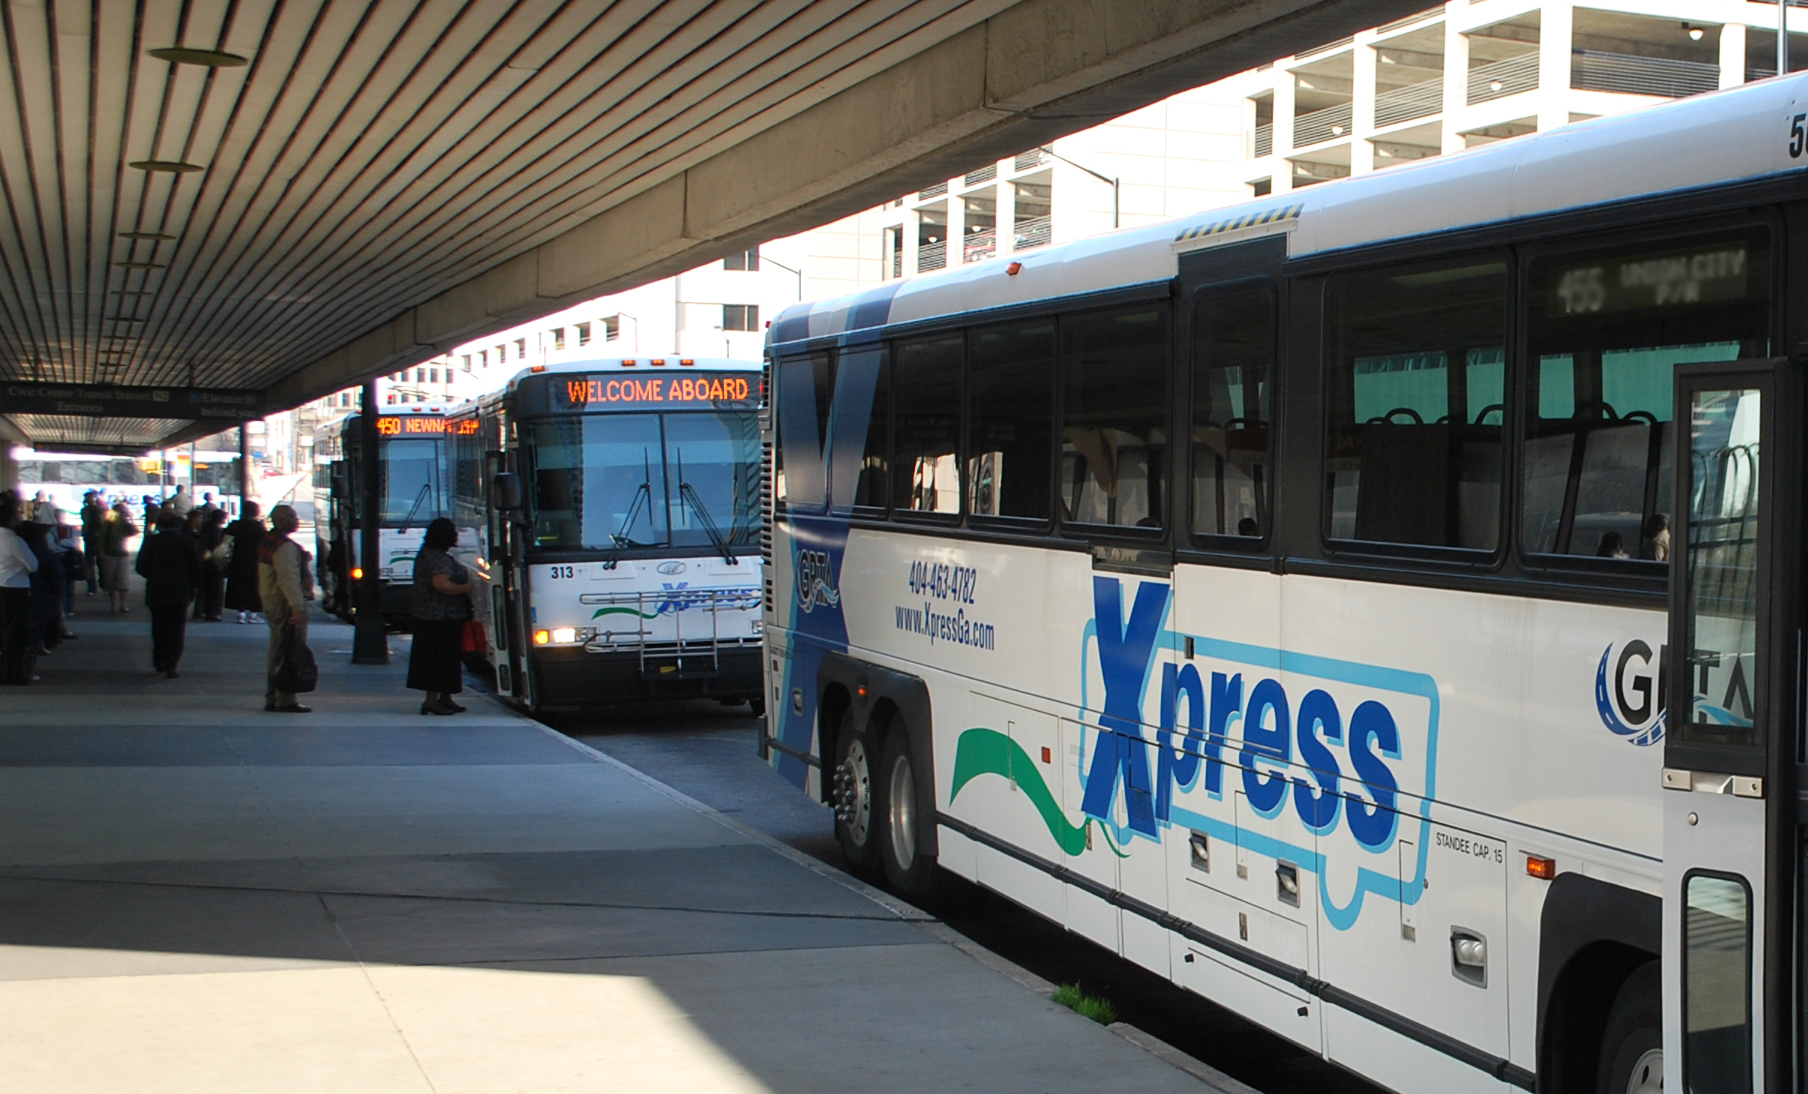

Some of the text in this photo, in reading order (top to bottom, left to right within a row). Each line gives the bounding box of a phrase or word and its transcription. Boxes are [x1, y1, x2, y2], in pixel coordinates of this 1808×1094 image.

[1789, 112, 1808, 158] 5
[1620, 249, 1746, 287] UNION CITY
[1558, 267, 1605, 313] 455
[8, 386, 36, 398] Civic
[38, 387, 75, 399] Center
[76, 388, 113, 400] Transit
[114, 390, 151, 401] Station
[203, 393, 244, 404] Elevator
[567, 378, 749, 403] WELCOME ABOARD
[57, 401, 104, 413] Entrance
[201, 407, 256, 420] behind you
[376, 417, 401, 435] 450
[551, 566, 574, 579] 313
[798, 549, 838, 609] GRTA
[909, 560, 976, 605] 404-463-4782
[895, 602, 994, 651] www.XpressGa.com
[1081, 575, 1401, 852] Xpress
[1436, 832, 1503, 863] STANDEE CAP. 15
